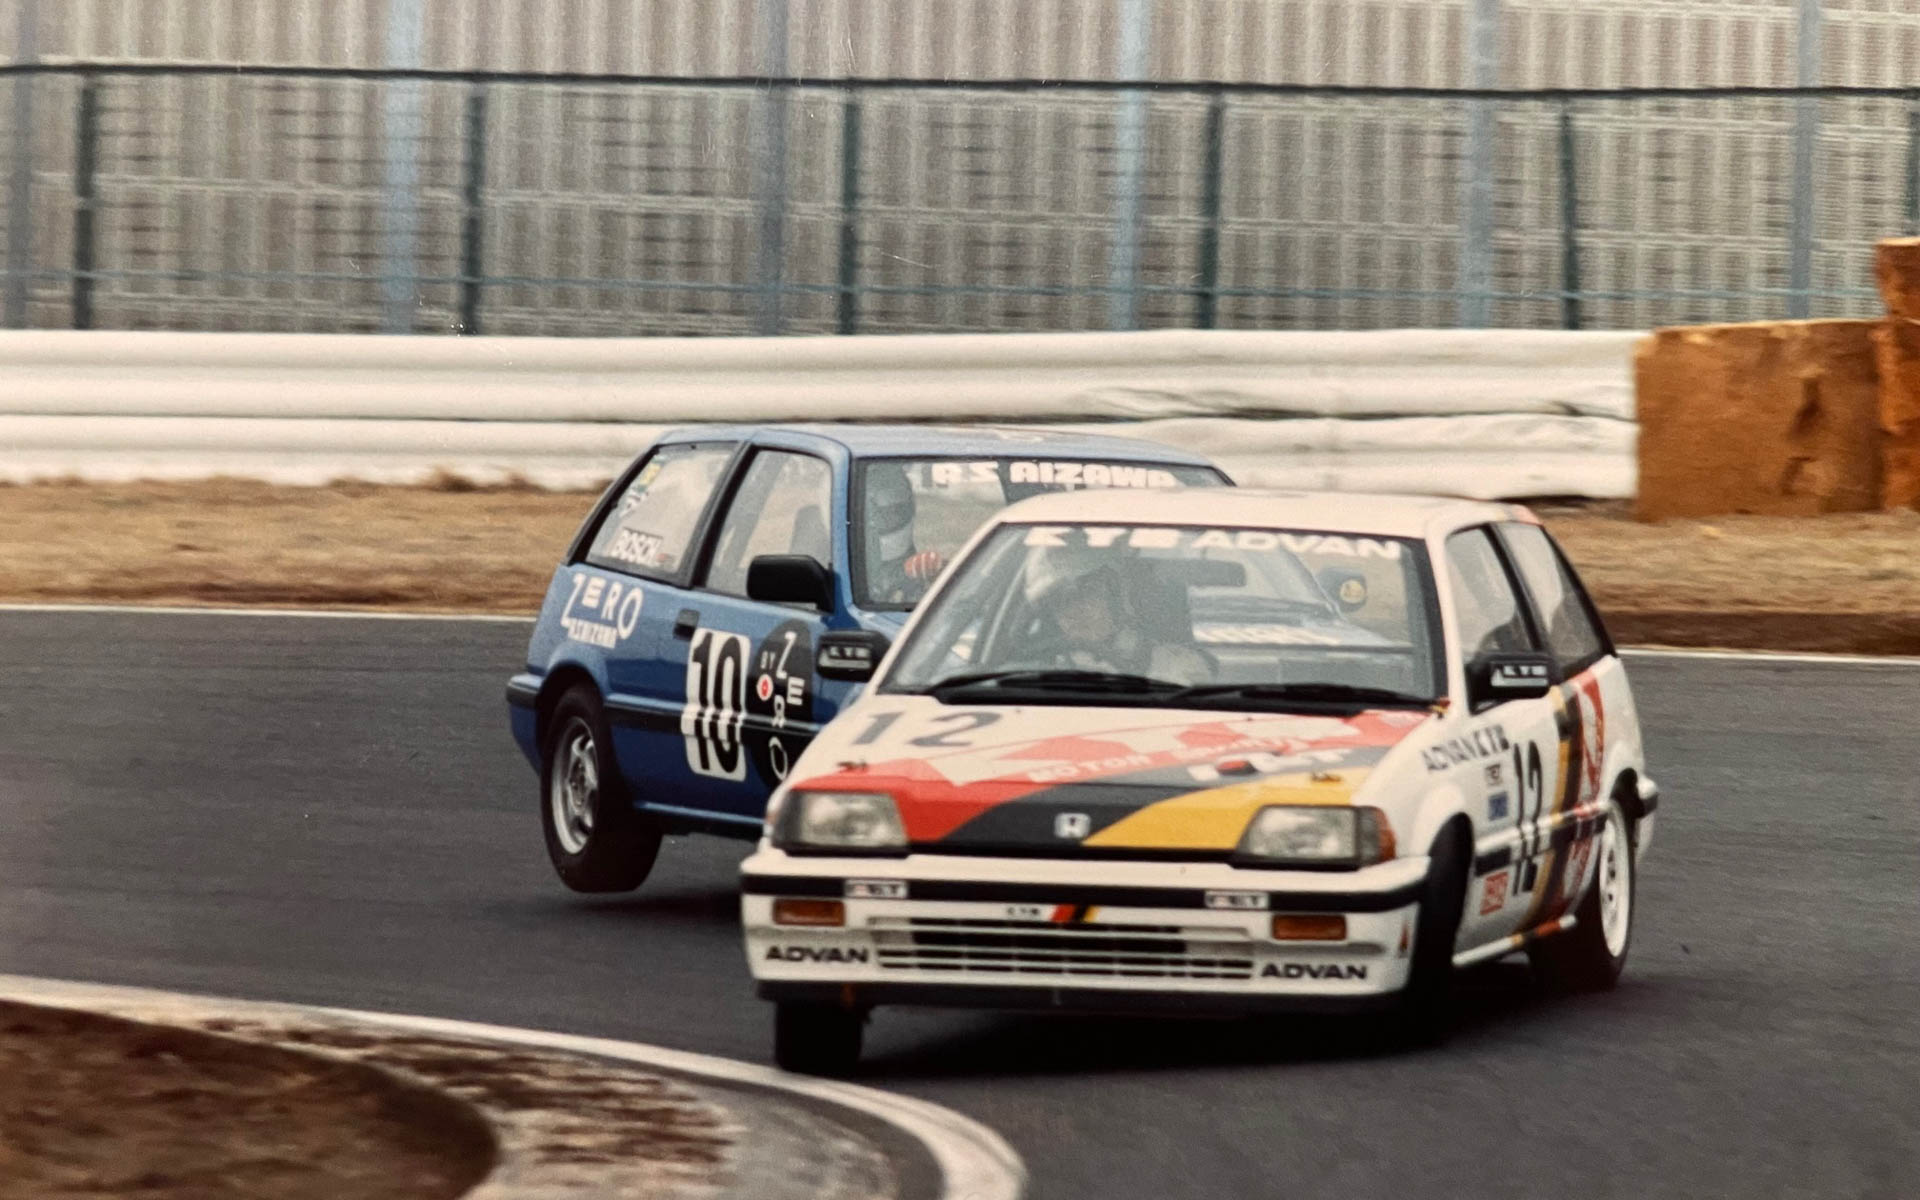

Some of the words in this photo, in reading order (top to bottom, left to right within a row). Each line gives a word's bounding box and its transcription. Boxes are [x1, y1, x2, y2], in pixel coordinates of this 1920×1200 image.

[1023, 526, 1183, 548] KYB
[1190, 530, 1402, 560] ADVAN
[560, 573, 644, 640] ZERO
[692, 631, 743, 774] 10
[850, 712, 1001, 748] 12
[766, 945, 868, 964] ADVAN
[1261, 962, 1368, 980] ADVAN
